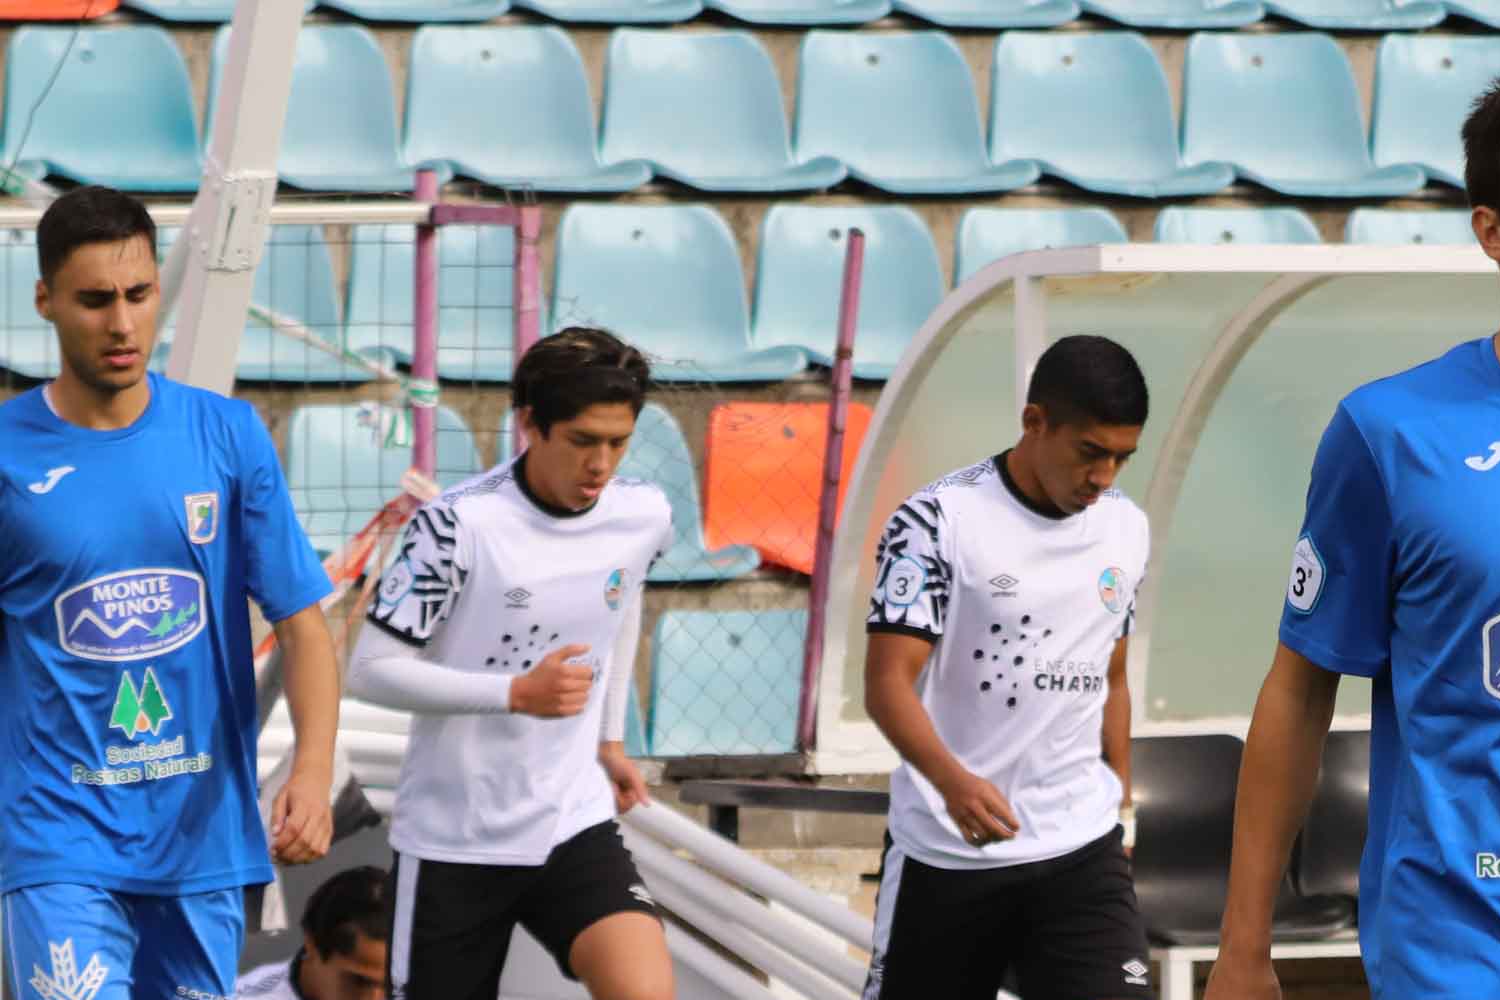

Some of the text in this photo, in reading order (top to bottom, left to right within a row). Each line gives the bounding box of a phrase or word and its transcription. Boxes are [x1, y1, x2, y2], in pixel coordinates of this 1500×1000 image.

[93, 576, 171, 603] MONTE
[104, 593, 174, 620] PINOS
[105, 735, 184, 765] Sociedad
[71, 763, 143, 785] Resnas
